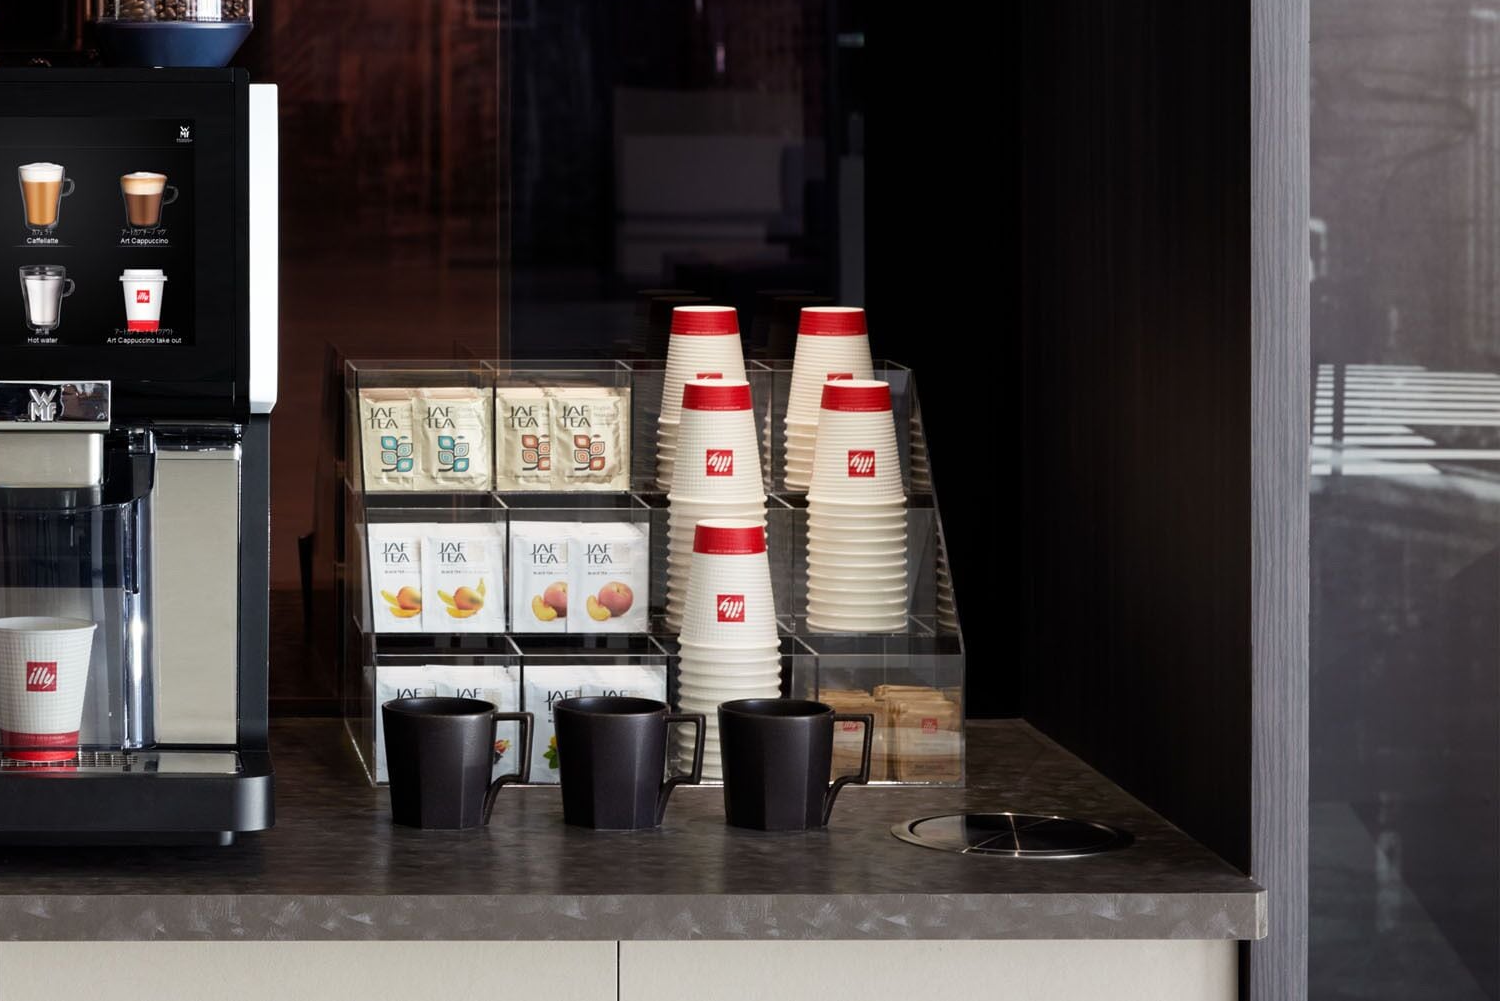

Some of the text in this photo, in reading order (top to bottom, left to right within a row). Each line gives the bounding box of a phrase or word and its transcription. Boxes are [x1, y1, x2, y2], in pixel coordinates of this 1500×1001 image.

[131, 237, 169, 245] Cappuccino
[27, 336, 40, 344] Hot
[117, 336, 155, 345] Cappuccino
[156, 336, 170, 344] take
[29, 387, 58, 422] WMF
[368, 406, 397, 418] JAF
[425, 406, 455, 418] JAF
[508, 405, 539, 417] JAF
[560, 405, 589, 417] JAF
[367, 418, 399, 430] TEA
[423, 418, 456, 429] TEA
[508, 416, 539, 428] TEA
[558, 416, 591, 428] TEA
[707, 451, 732, 473] illy
[850, 452, 875, 473] illy
[383, 542, 409, 553] JAF
[440, 542, 466, 553] JAF
[531, 543, 557, 554] JAF
[586, 543, 612, 554] JAF
[381, 552, 410, 563] TEA
[437, 552, 467, 563] TEA
[529, 553, 559, 564] TEA
[583, 553, 613, 564] TEA
[719, 597, 744, 619] illy
[28, 666, 56, 690] illy
[396, 687, 422, 700] JAF
[456, 687, 482, 699] JAF
[545, 689, 575, 702] JAF
